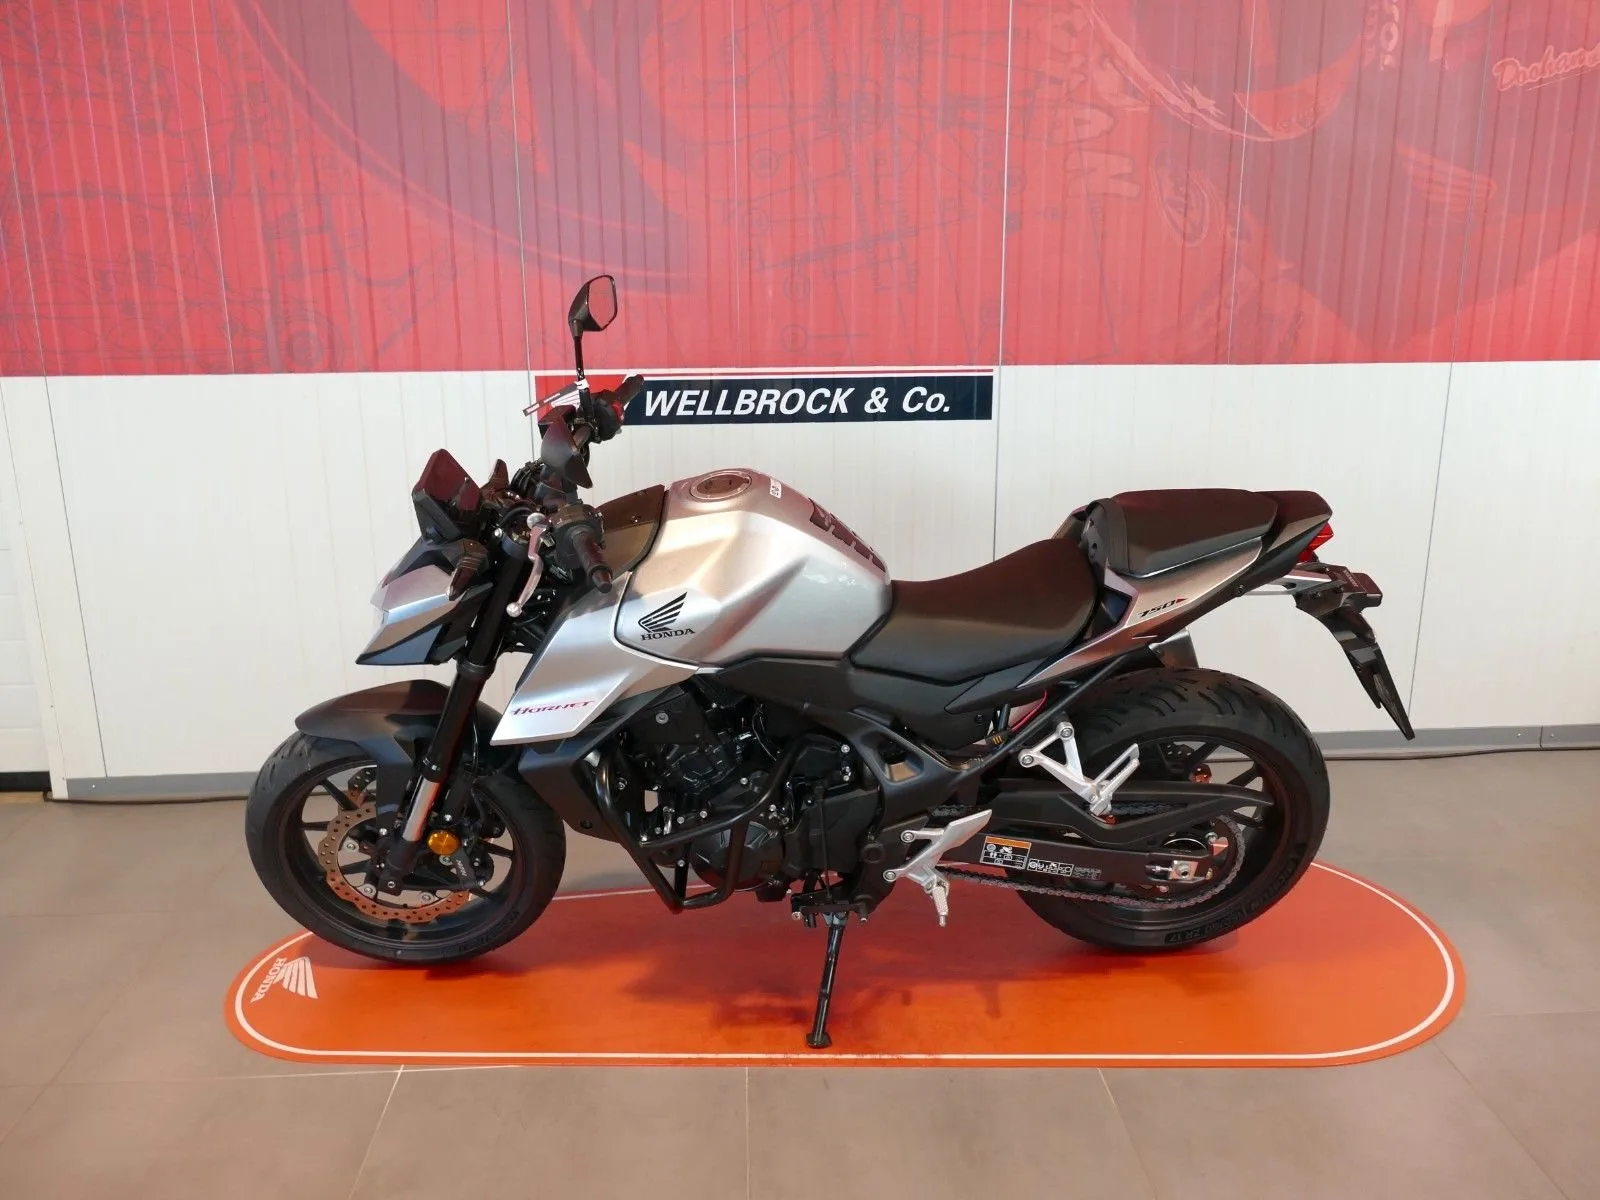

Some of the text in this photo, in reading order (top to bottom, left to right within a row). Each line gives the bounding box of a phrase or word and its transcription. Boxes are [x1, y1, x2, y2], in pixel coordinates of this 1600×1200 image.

[645, 386, 951, 417] WELLBROCK & Co.
[1138, 599, 1176, 617] 750
[640, 628, 696, 641] HONDA
[511, 699, 597, 716] HORNET
[250, 957, 288, 1003] HONDA
